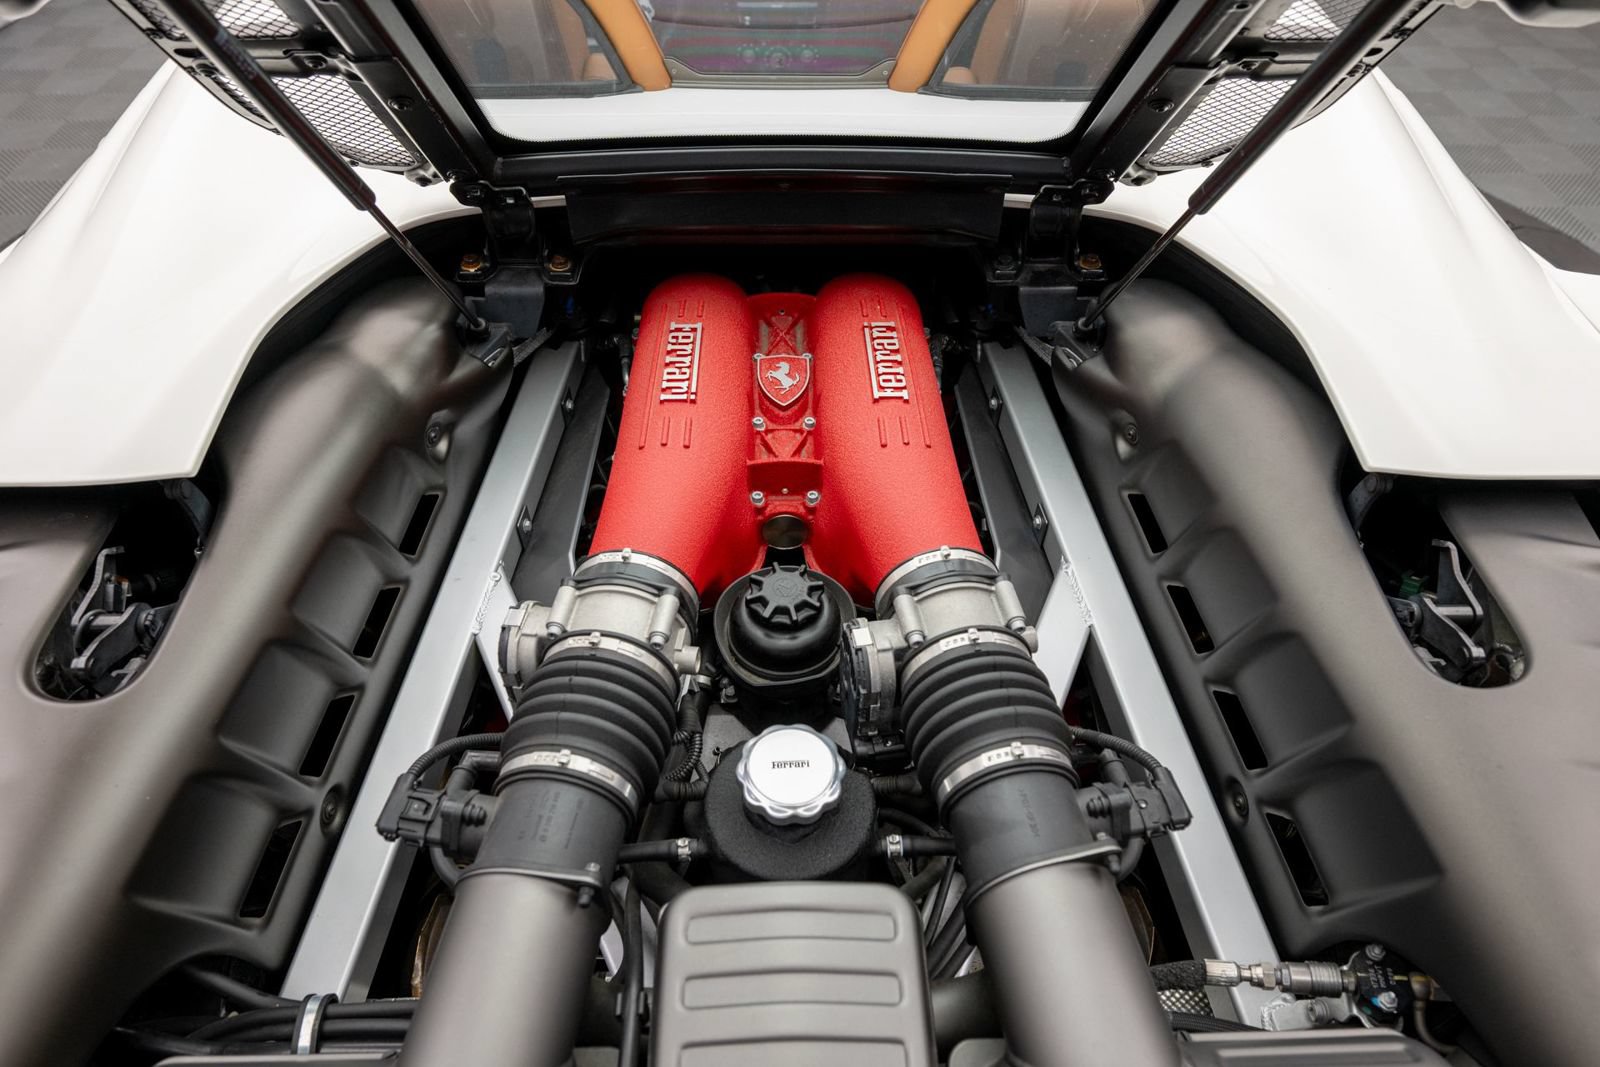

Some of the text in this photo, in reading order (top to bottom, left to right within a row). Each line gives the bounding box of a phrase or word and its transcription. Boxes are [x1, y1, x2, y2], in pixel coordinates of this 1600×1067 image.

[660, 321, 702, 402] Ferrari
[863, 321, 909, 400] Ferrari
[771, 760, 810, 769] Ferrari
